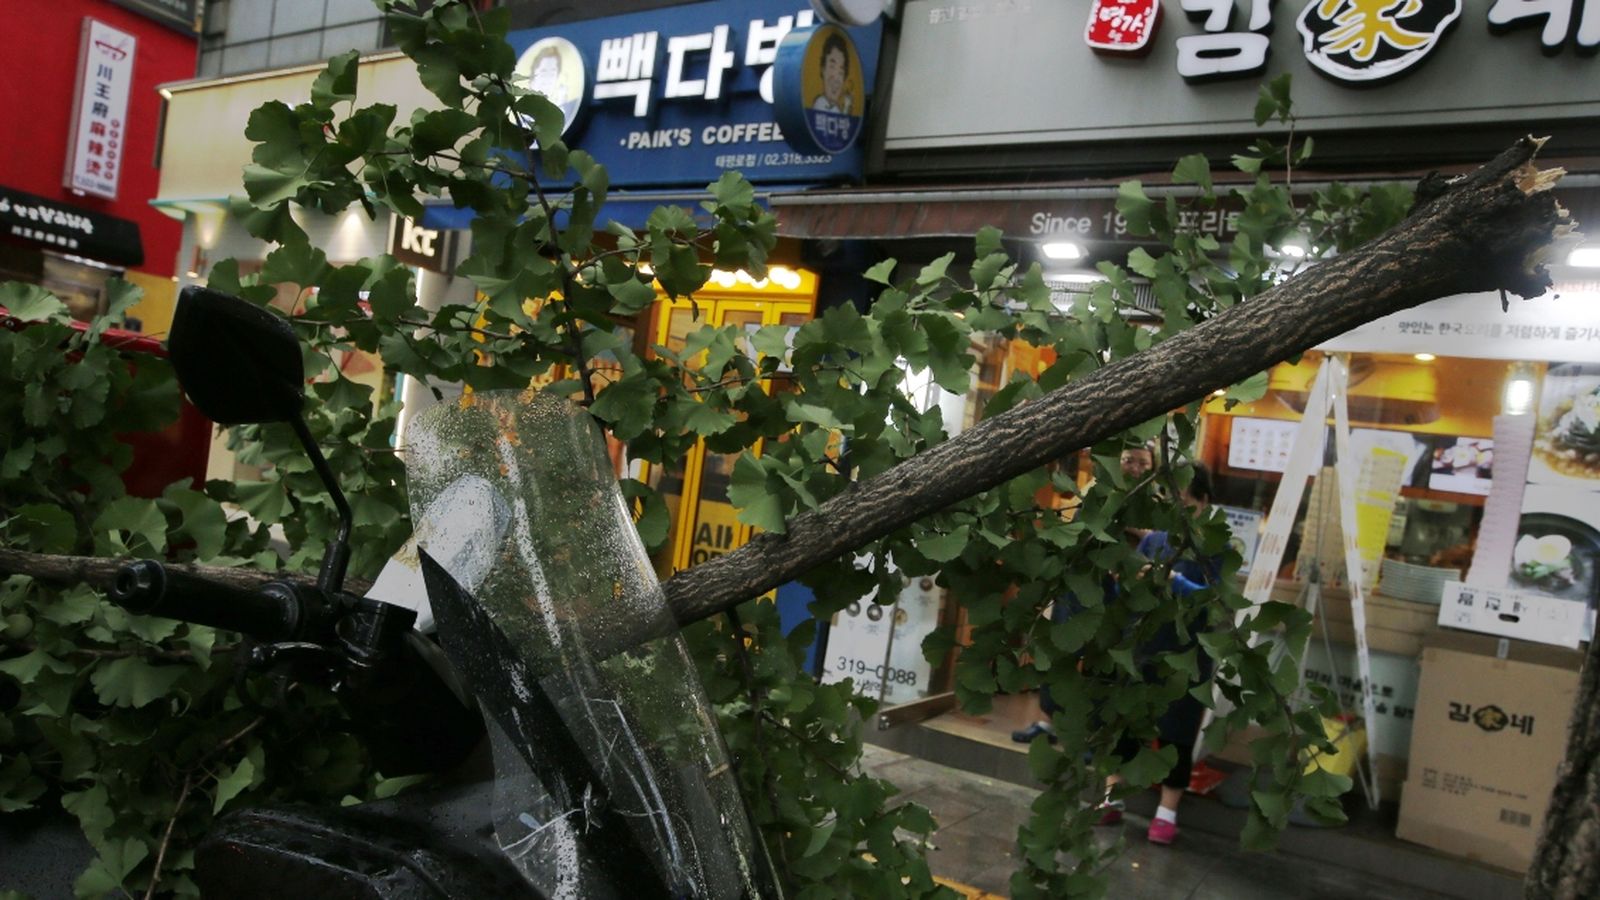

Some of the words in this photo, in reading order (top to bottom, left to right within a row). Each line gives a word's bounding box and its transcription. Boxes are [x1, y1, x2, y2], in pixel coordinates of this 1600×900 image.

[627, 128, 691, 150] PAIK'S
[815, 113, 851, 140] 빽다방
[402, 215, 438, 257] kt
[1030, 211, 1092, 235] Since
[836, 656, 917, 687] 319-0088
